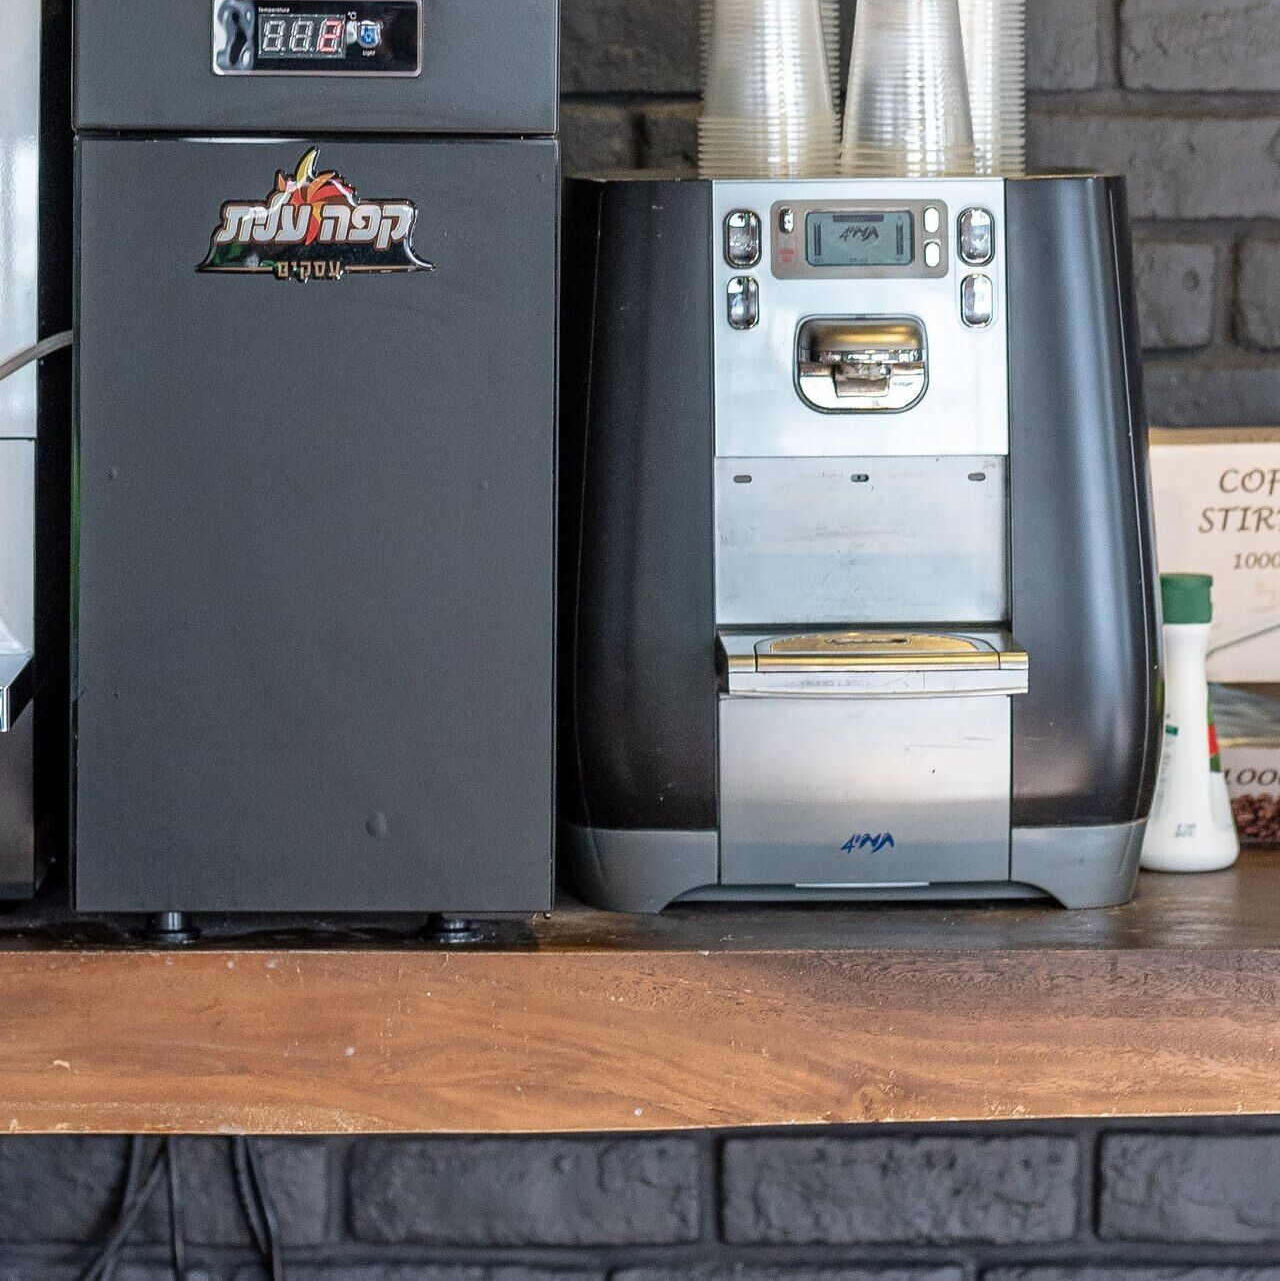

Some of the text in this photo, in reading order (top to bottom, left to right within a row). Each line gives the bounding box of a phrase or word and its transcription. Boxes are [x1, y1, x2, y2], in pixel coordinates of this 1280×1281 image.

[216, 192, 415, 250] קפה עלית
[277, 261, 342, 279] עסקים
